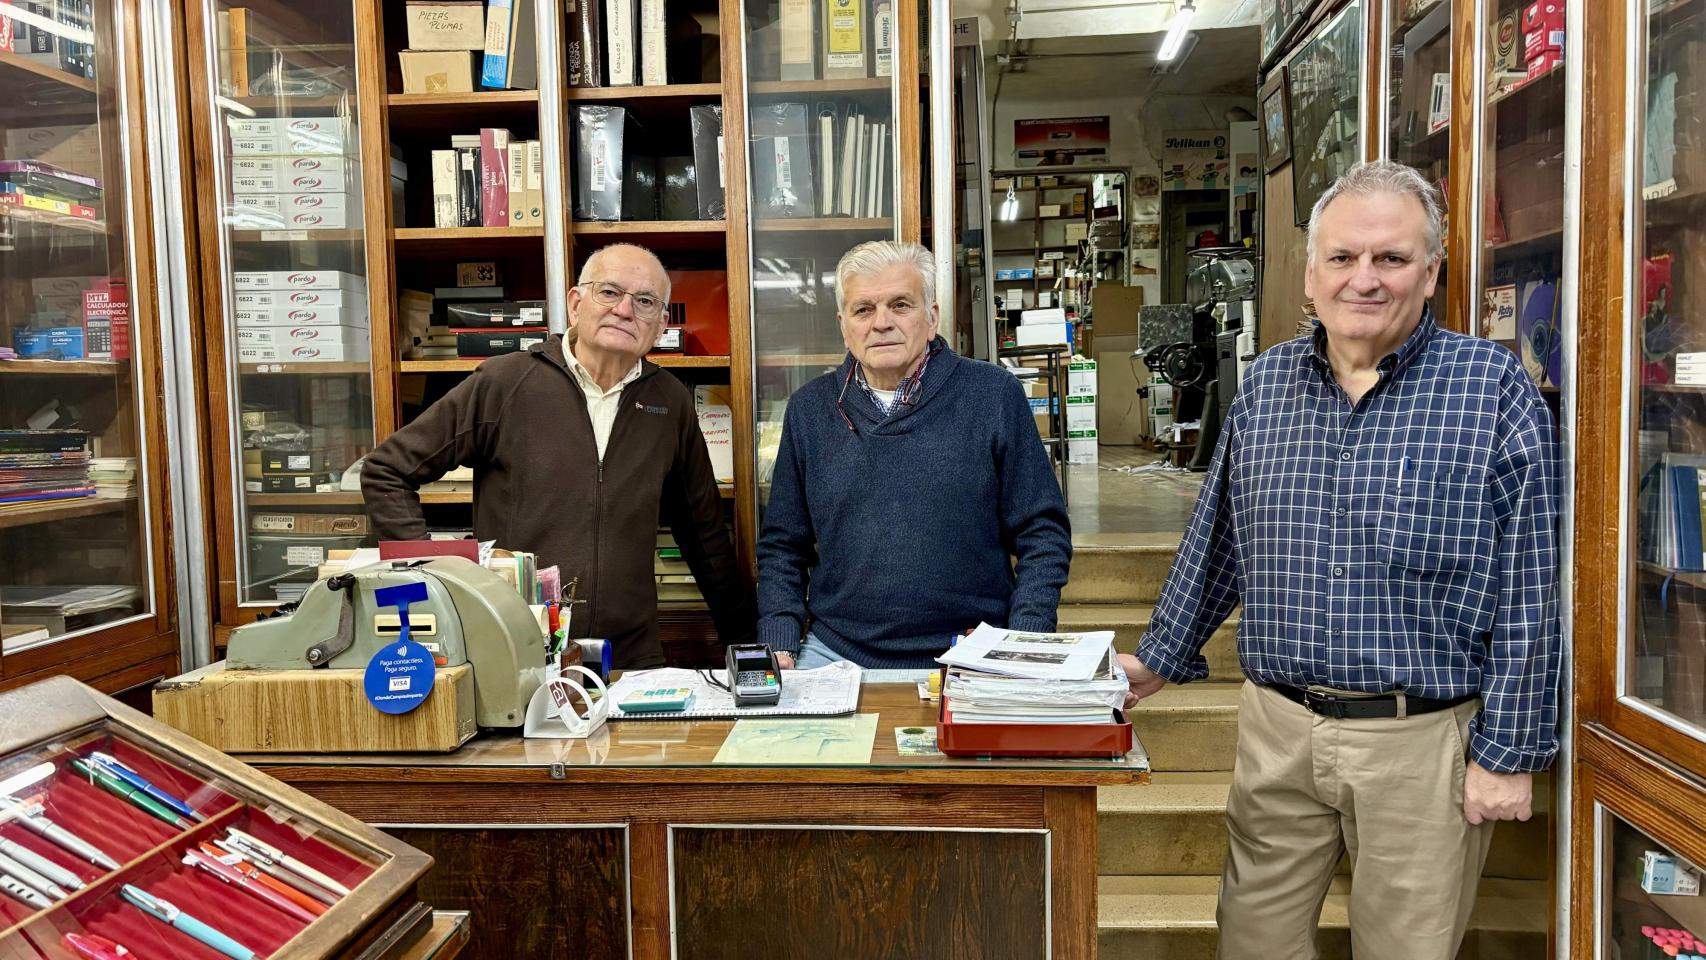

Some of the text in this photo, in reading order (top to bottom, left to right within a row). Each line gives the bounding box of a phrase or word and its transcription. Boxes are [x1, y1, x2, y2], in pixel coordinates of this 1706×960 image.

[419, 11, 449, 20] PIEZAS
[429, 21, 464, 31] PLUMAS
[954, 23, 969, 34] HE
[568, 41, 576, 72] AGENDA
[1165, 138, 1210, 149] Pelikan
[298, 160, 316, 169] pardo
[299, 177, 316, 187] pardo
[300, 196, 317, 205] pardo
[81, 209, 94, 217] APLI
[300, 214, 316, 223] pardo
[293, 274, 310, 283] pardo
[87, 293, 109, 302] MTL
[296, 293, 313, 302] pardo
[294, 310, 311, 320] pardo
[296, 328, 313, 337] pardo
[297, 347, 315, 356] pardo
[332, 518, 358, 531] pardo
